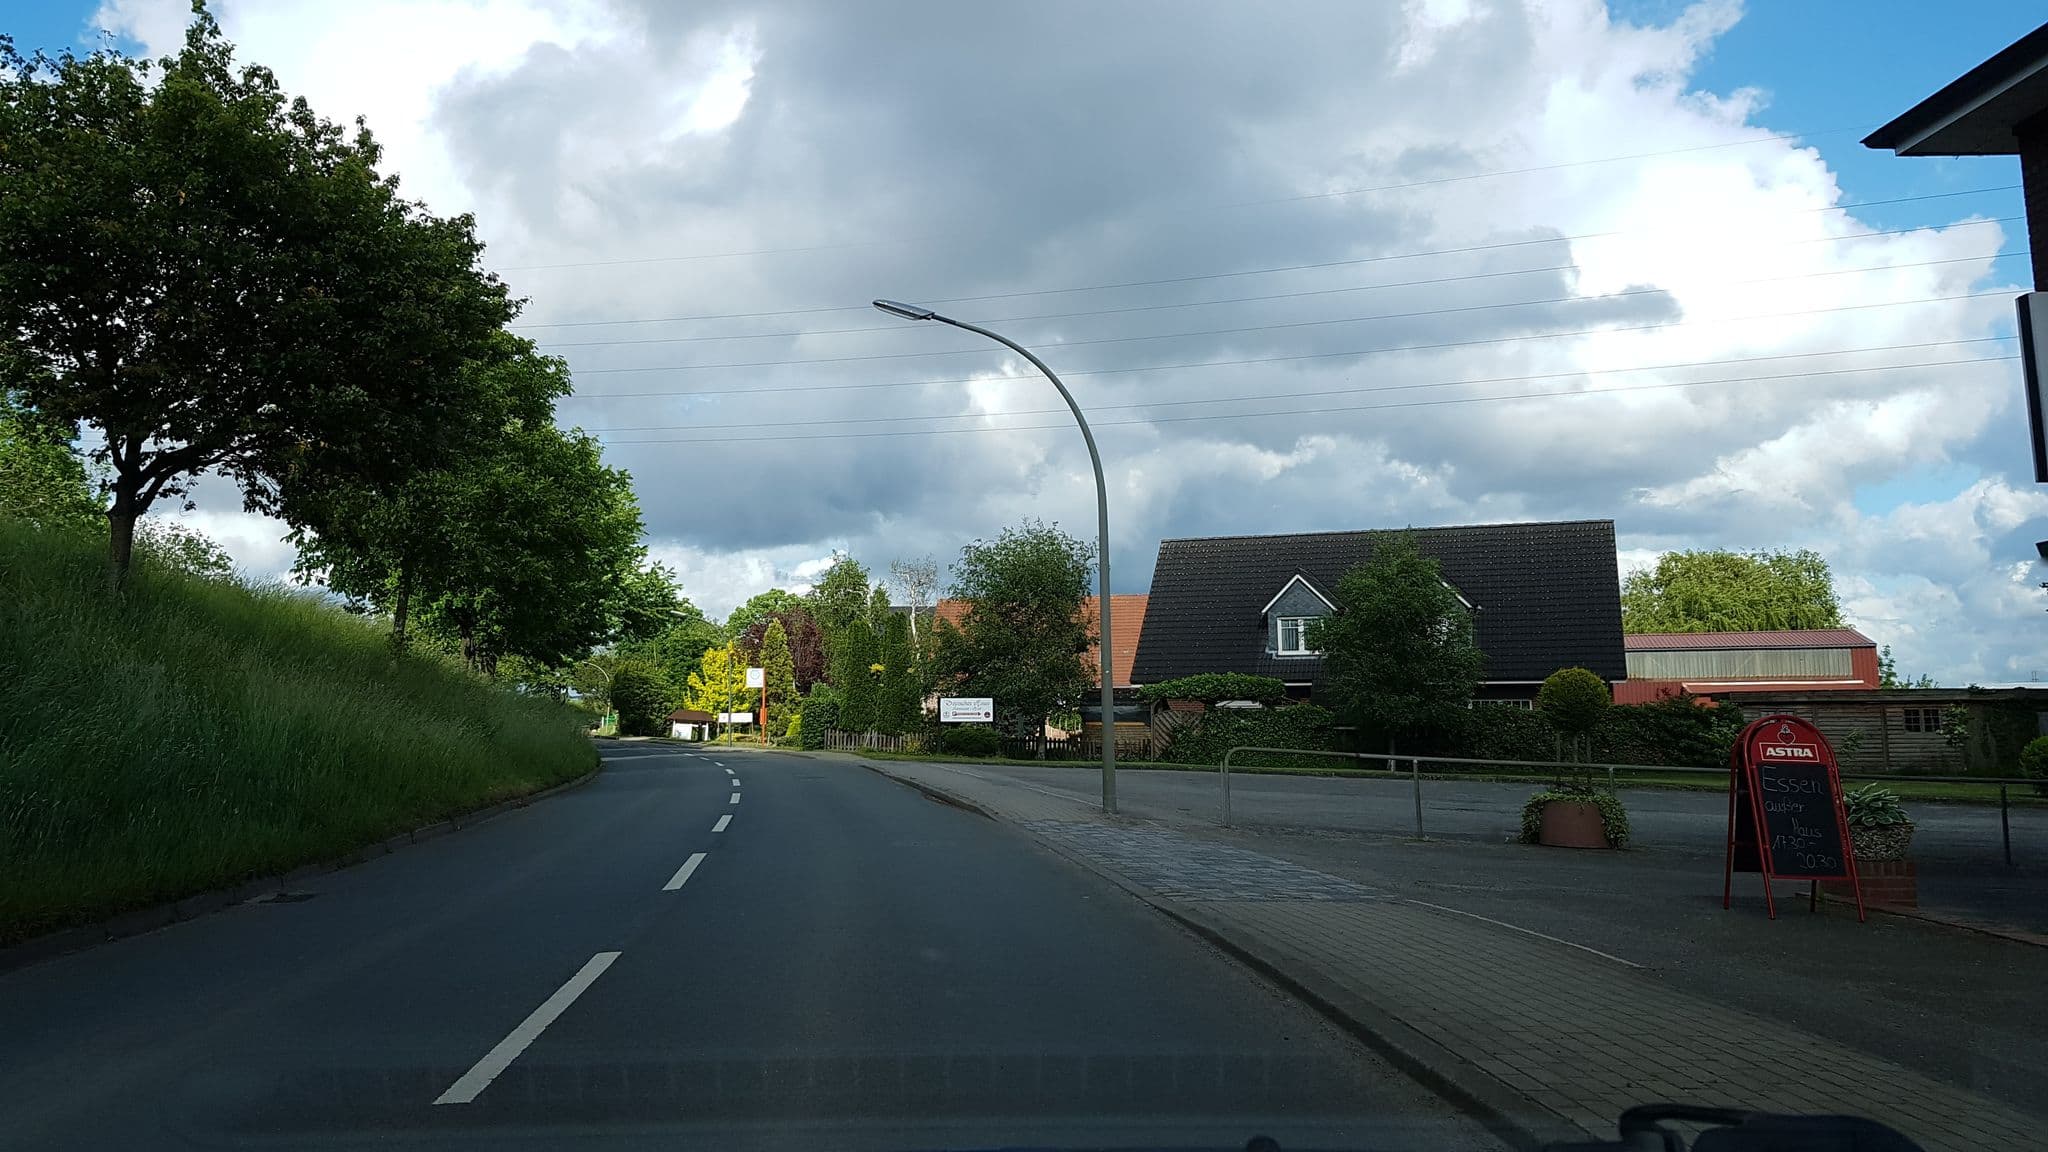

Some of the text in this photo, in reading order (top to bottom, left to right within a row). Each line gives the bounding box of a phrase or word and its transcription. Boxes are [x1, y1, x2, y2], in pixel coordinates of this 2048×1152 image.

[1766, 747, 1813, 757] ASTRA
[1762, 766, 1824, 794] Essen
[1791, 817, 1822, 837] Haus
